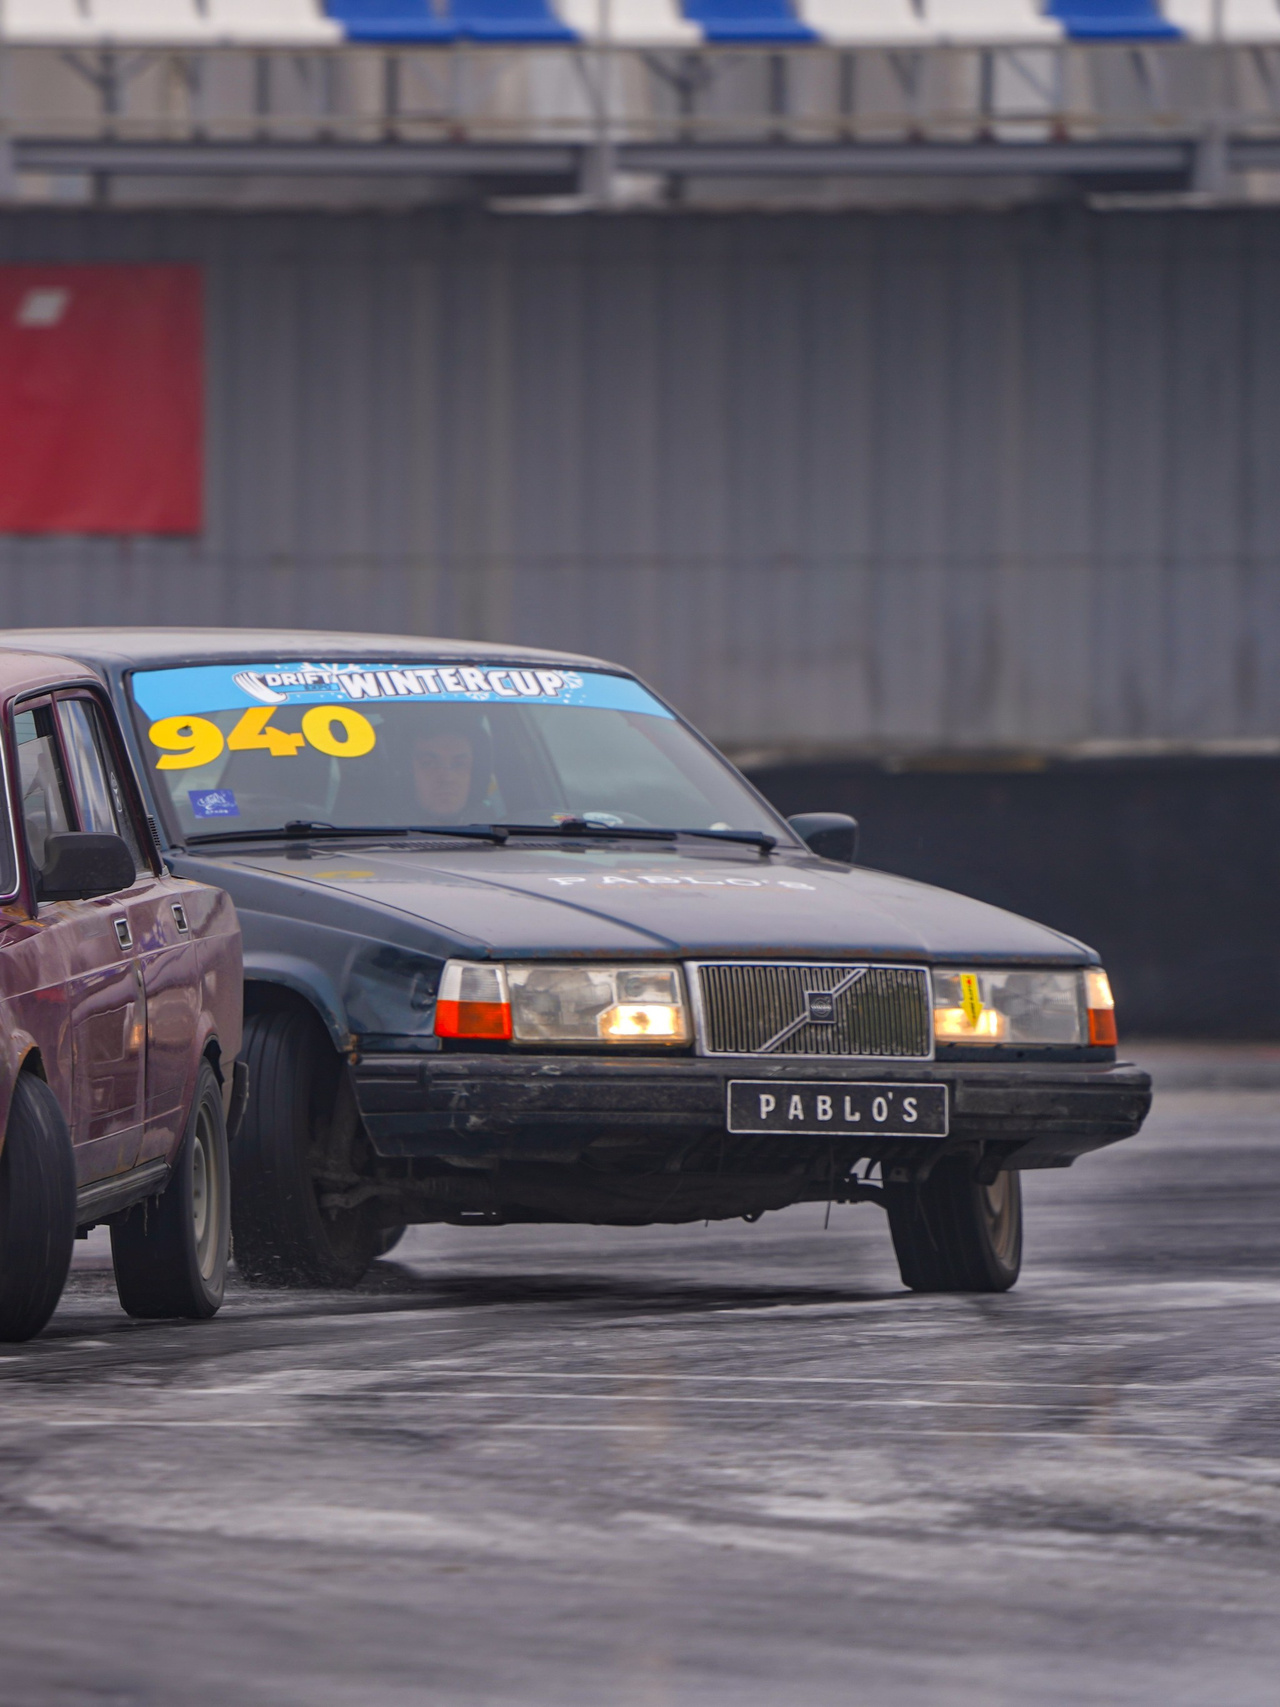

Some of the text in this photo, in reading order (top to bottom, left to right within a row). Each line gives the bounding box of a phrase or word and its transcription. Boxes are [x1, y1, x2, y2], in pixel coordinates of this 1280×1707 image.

[265, 671, 332, 687] DRIFT
[149, 705, 376, 770] 940
[758, 1092, 918, 1123] PABLO'S
